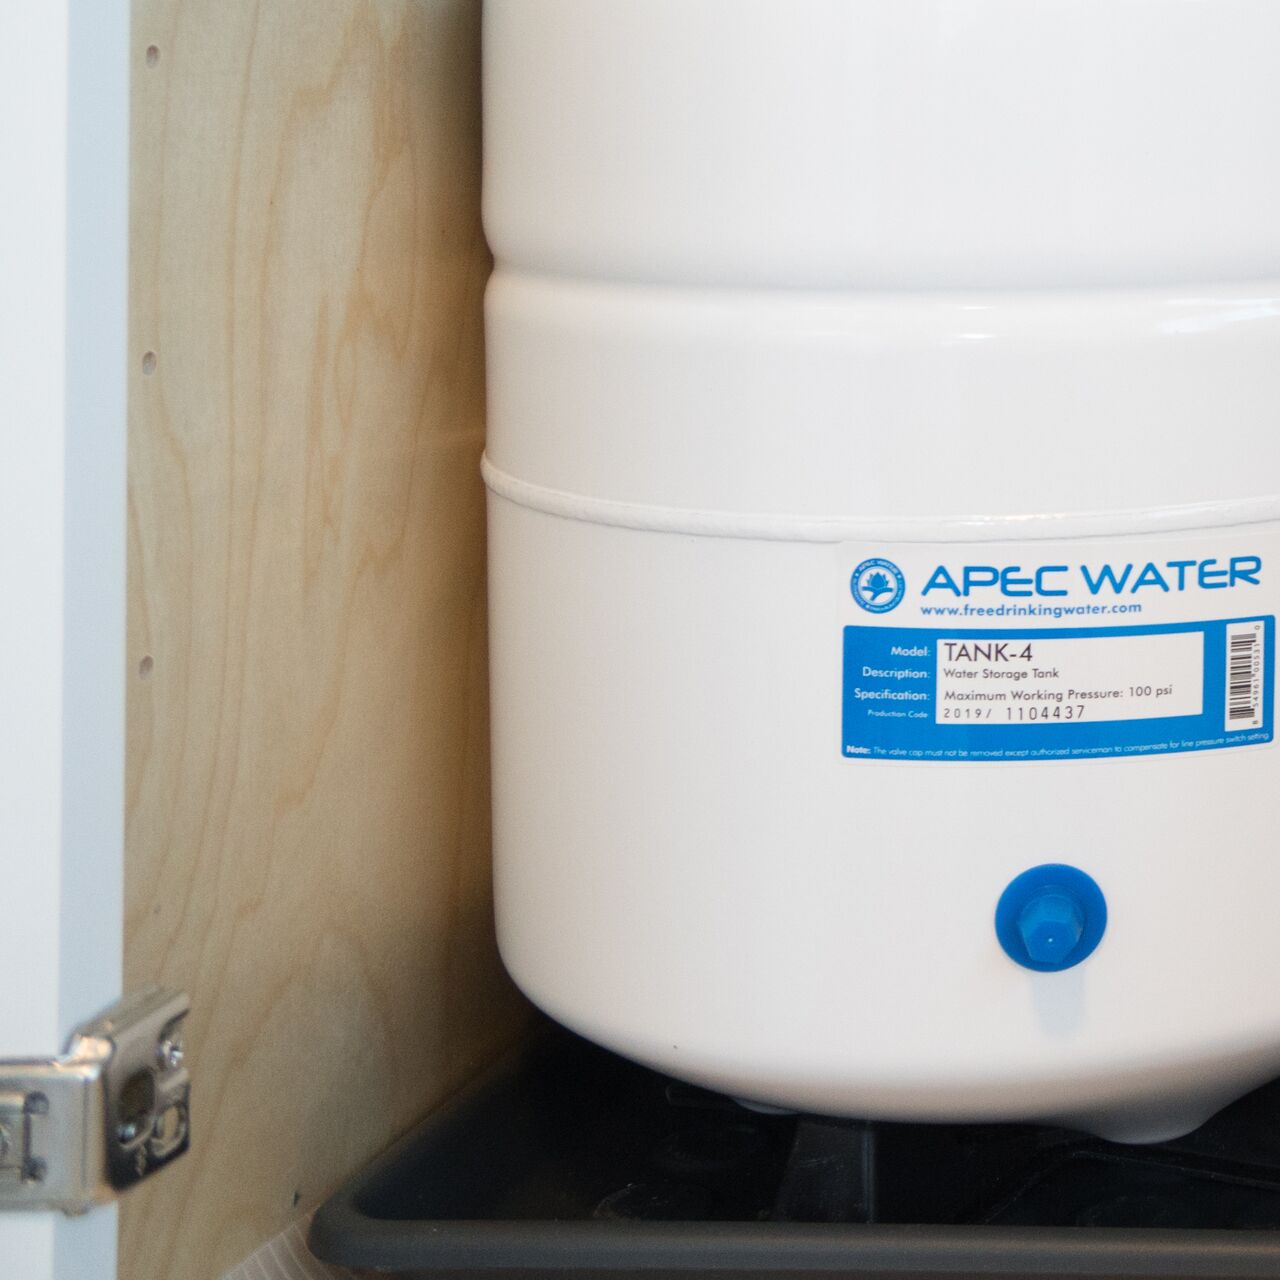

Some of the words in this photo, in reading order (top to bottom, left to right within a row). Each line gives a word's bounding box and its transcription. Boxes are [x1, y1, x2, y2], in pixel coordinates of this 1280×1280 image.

[921, 565, 1068, 597] APEC
[1080, 556, 1262, 595] WATER
[920, 603, 1142, 618] www.freedrinkingwater.com
[891, 646, 930, 657] Model:
[944, 643, 1033, 662] TANK-4
[862, 666, 930, 680] Description:
[944, 668, 978, 679] Water
[982, 668, 1028, 681] Storage
[1032, 667, 1059, 679] Tank
[854, 688, 930, 701] Specification:
[944, 690, 1006, 701] Maximum
[1011, 689, 1062, 703] Working
[1068, 688, 1123, 700] Pressure:
[1129, 685, 1152, 697] 100
[1156, 684, 1173, 698] psi
[868, 709, 906, 718] Production
[944, 707, 992, 718] 2019/
[1007, 705, 1084, 721] 1104437
[846, 745, 872, 755] Note:
[874, 745, 887, 755] The
[888, 747, 907, 756] valve
[908, 749, 923, 758] cap
[925, 748, 943, 757] must
[944, 748, 957, 757] not
[958, 748, 968, 757] be
[970, 748, 1003, 757] removed
[1005, 748, 1028, 758] except
[1030, 745, 1069, 756] authorized
[1071, 746, 1113, 755] serviceman
[1114, 745, 1122, 753] to
[1124, 742, 1168, 754] compensate
[1170, 740, 1180, 749] for
[1195, 737, 1224, 748] pressure
[1226, 734, 1246, 744] switch
